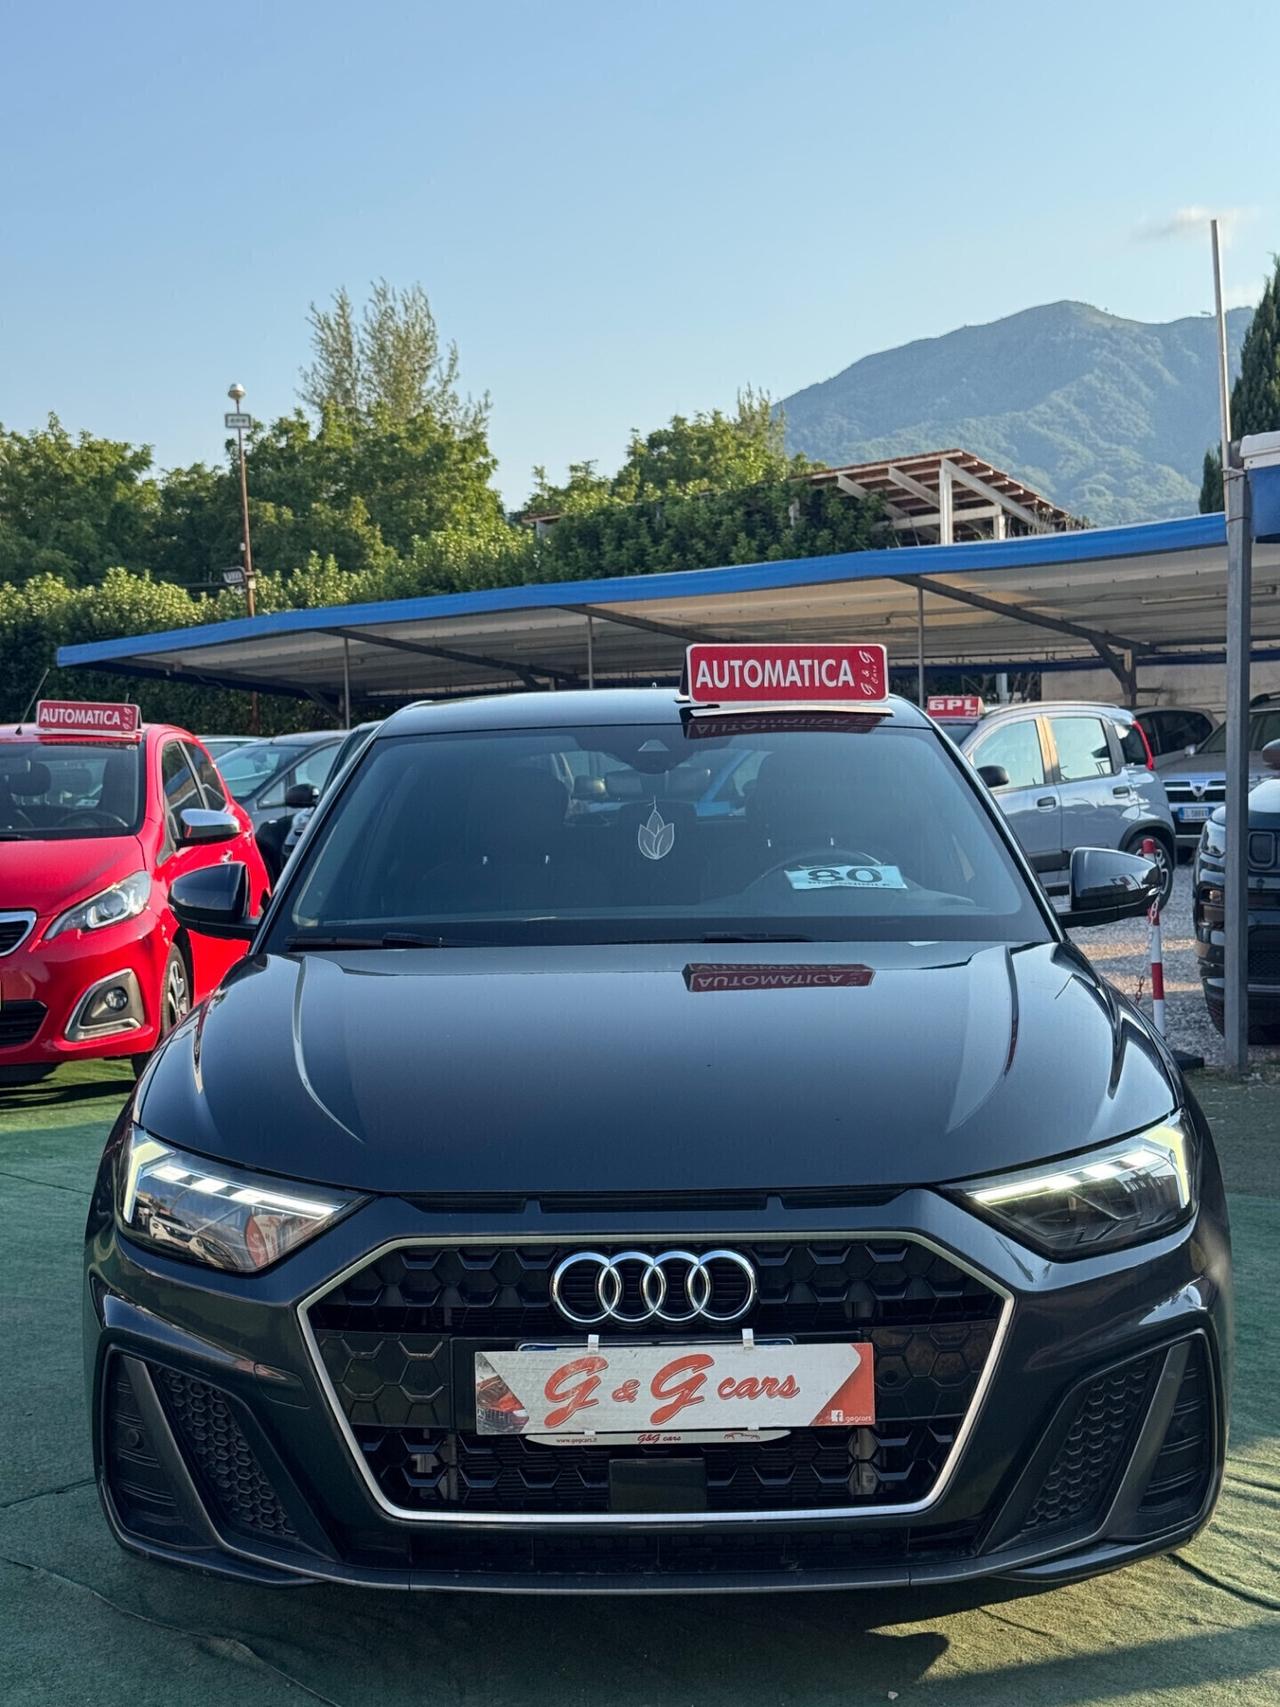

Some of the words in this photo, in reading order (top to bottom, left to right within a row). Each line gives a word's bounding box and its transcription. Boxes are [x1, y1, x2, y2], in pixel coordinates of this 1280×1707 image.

[695, 659, 856, 688] AUTOMATICA
[929, 699, 977, 711] GPL
[40, 708, 121, 726] AUTOMATICA
[543, 1354, 609, 1429] G
[611, 1378, 641, 1403] &
[650, 1353, 715, 1427] G
[717, 1373, 801, 1401] cars
